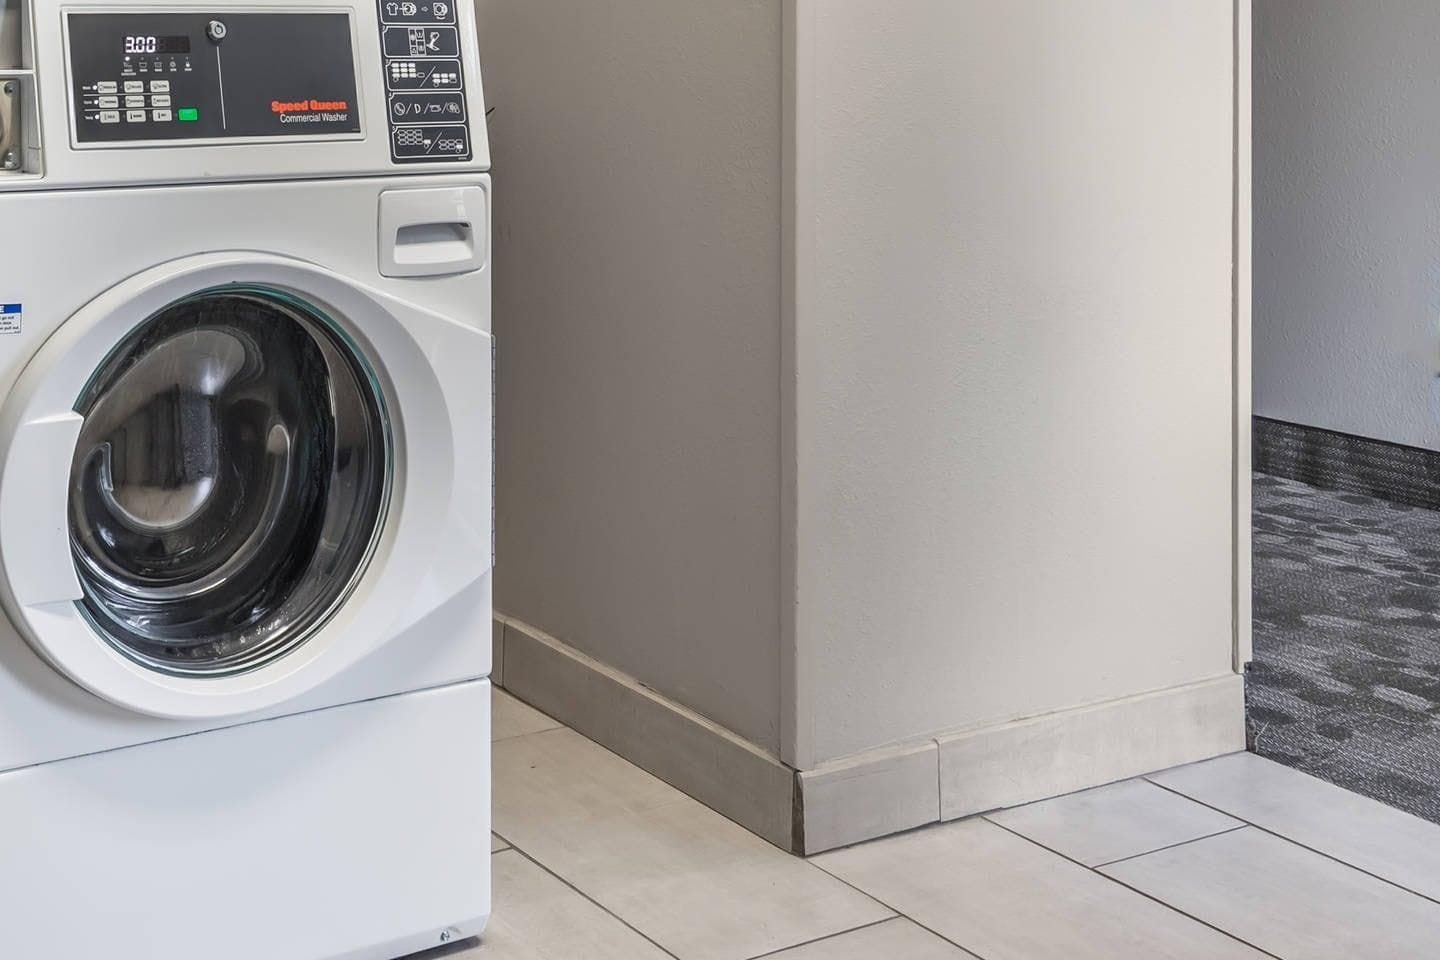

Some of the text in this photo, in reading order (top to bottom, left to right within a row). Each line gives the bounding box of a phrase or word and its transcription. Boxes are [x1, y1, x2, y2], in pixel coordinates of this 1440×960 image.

[125, 36, 156, 53] 3.00
[271, 100, 347, 113] Speed Queen
[280, 113, 348, 123] Commercial Washer
